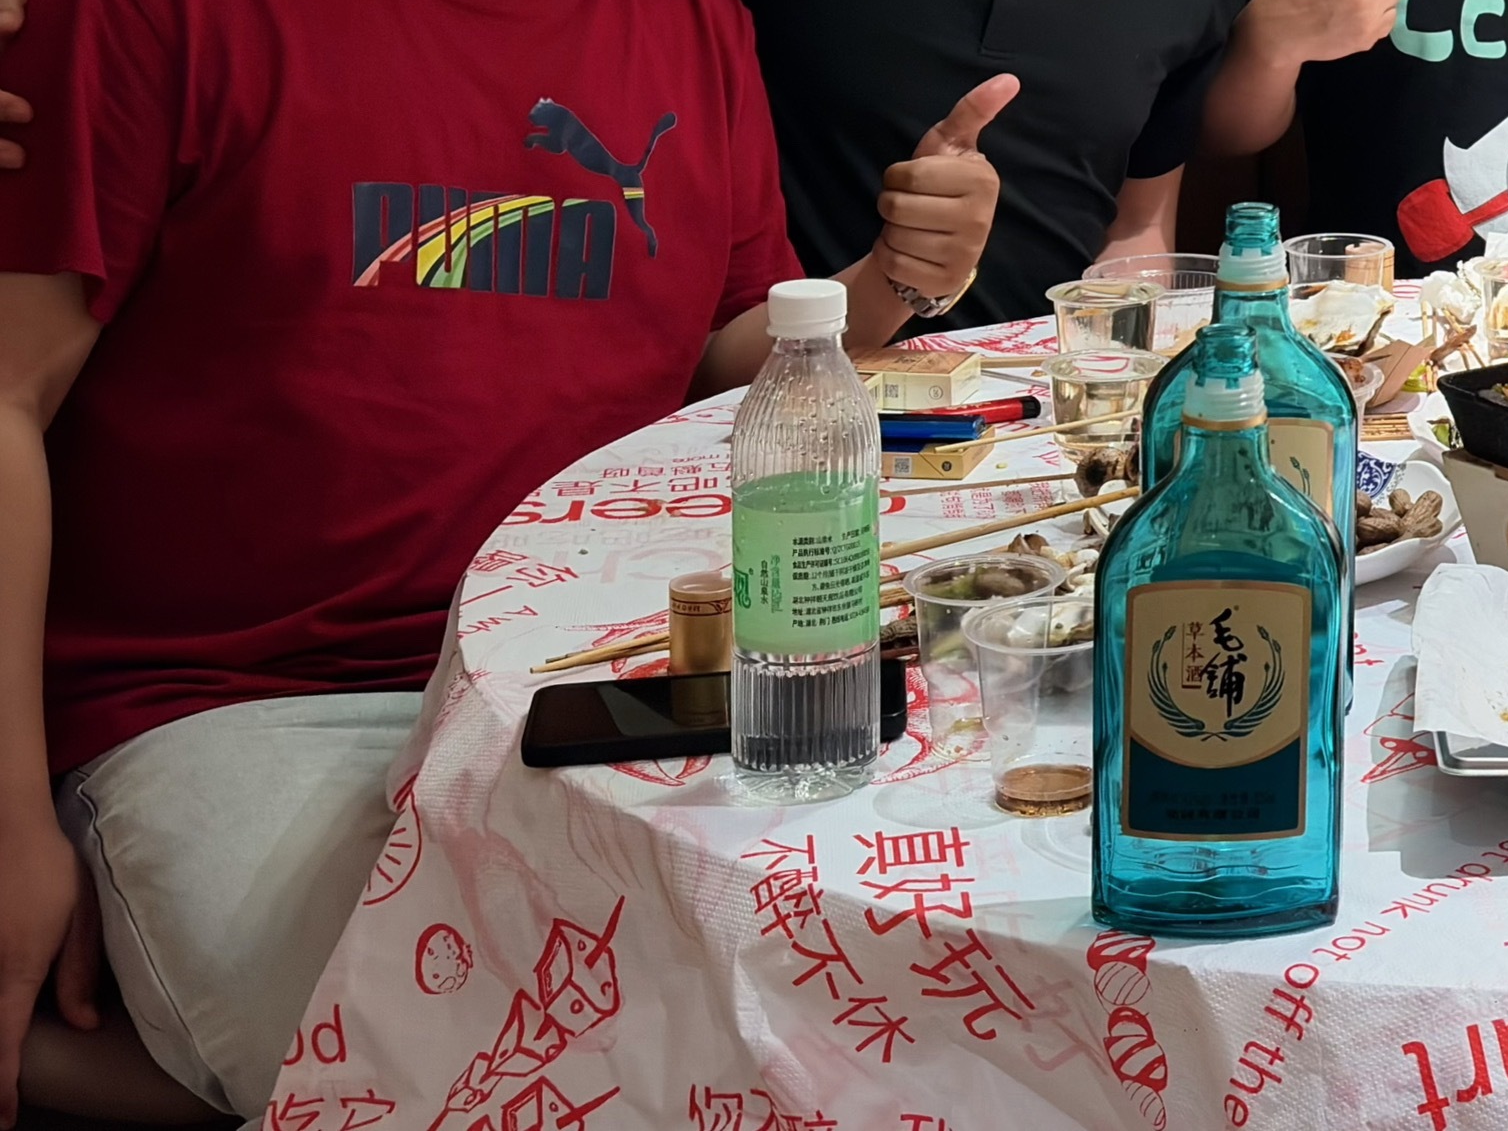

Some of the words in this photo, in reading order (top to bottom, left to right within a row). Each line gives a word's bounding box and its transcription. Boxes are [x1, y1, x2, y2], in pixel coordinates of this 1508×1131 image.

[352, 182, 616, 300] PUMA
[1185, 621, 1206, 683] 草本酒
[1380, 863, 1493, 919] drunk
[740, 834, 916, 1063] 不醉不休
[853, 826, 1036, 1041] 真好玩
[1312, 921, 1391, 961] not
[1264, 963, 1320, 1041] off
[1224, 1040, 1285, 1127] the
